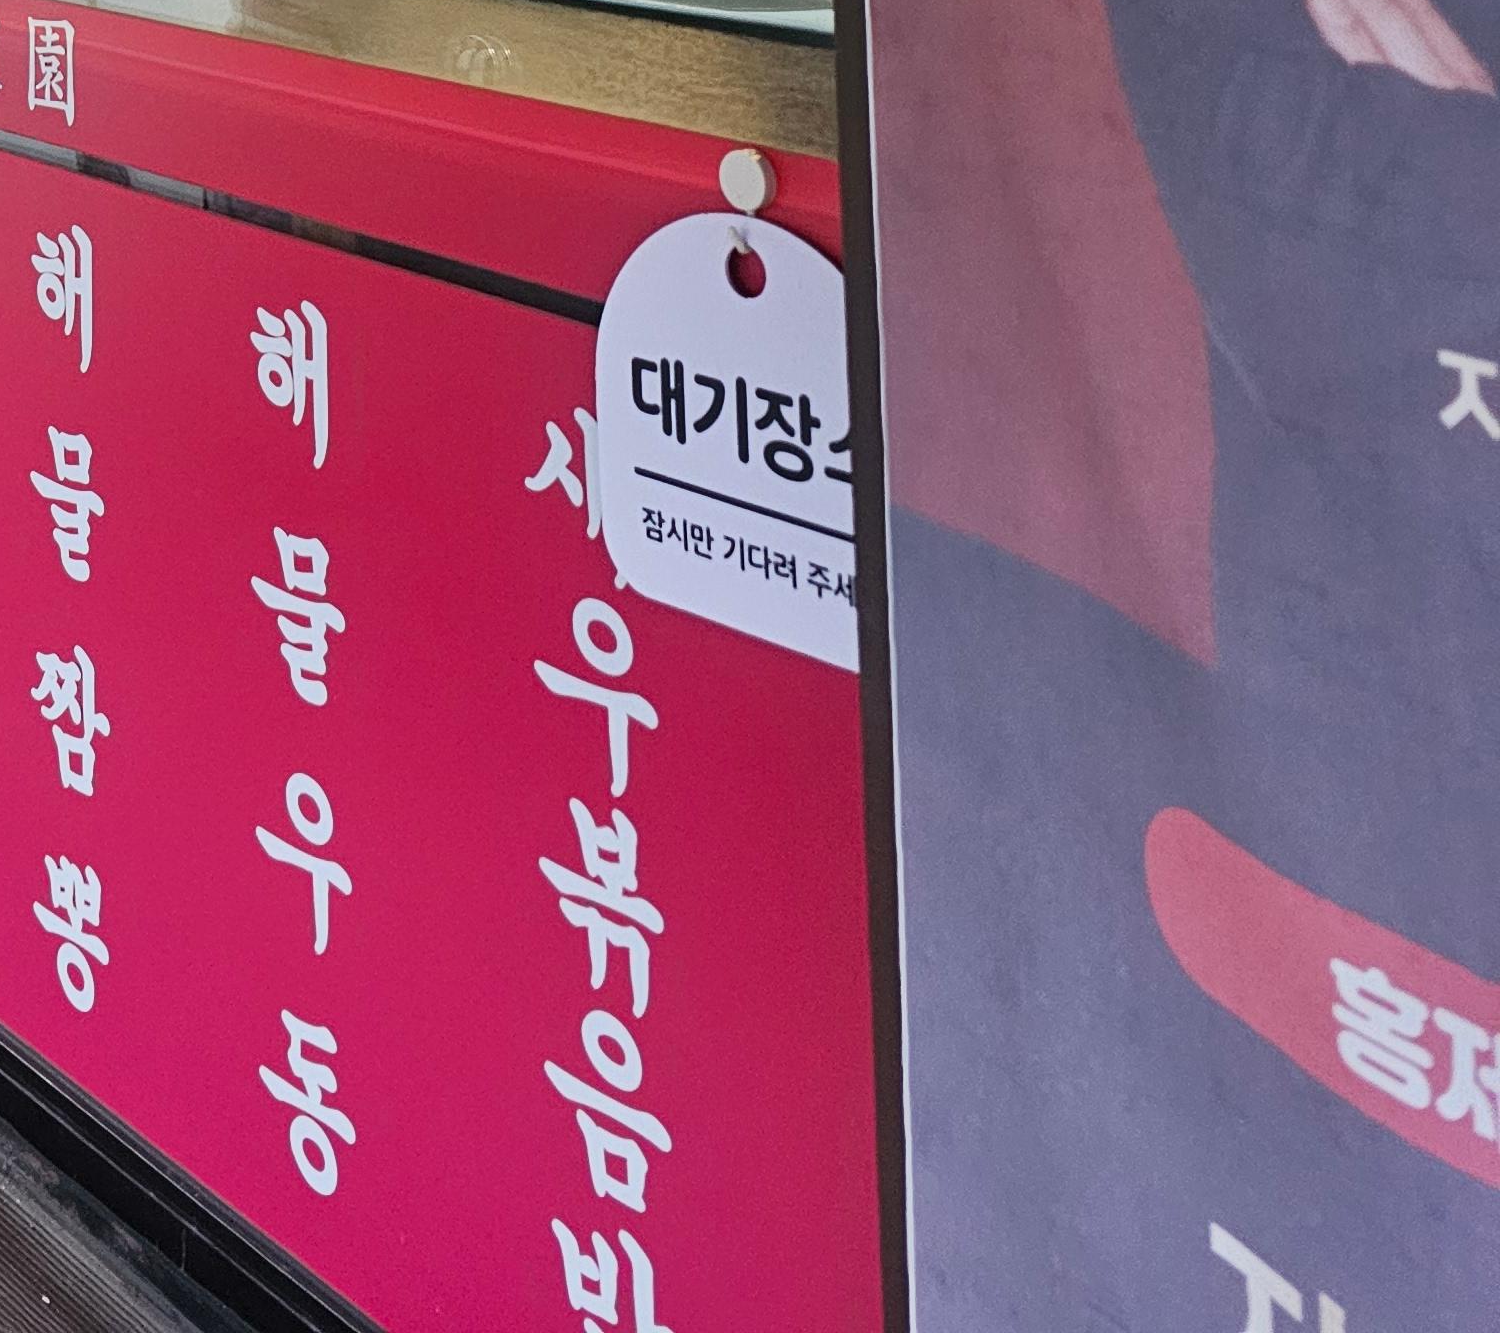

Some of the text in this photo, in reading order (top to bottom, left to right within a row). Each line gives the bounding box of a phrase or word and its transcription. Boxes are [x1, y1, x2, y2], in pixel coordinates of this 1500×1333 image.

[29, 223, 111, 1016] 해물짬뽕
[248, 298, 357, 1200] 해물우동
[642, 507, 713, 560] 잠시만
[723, 535, 798, 590] 기다려
